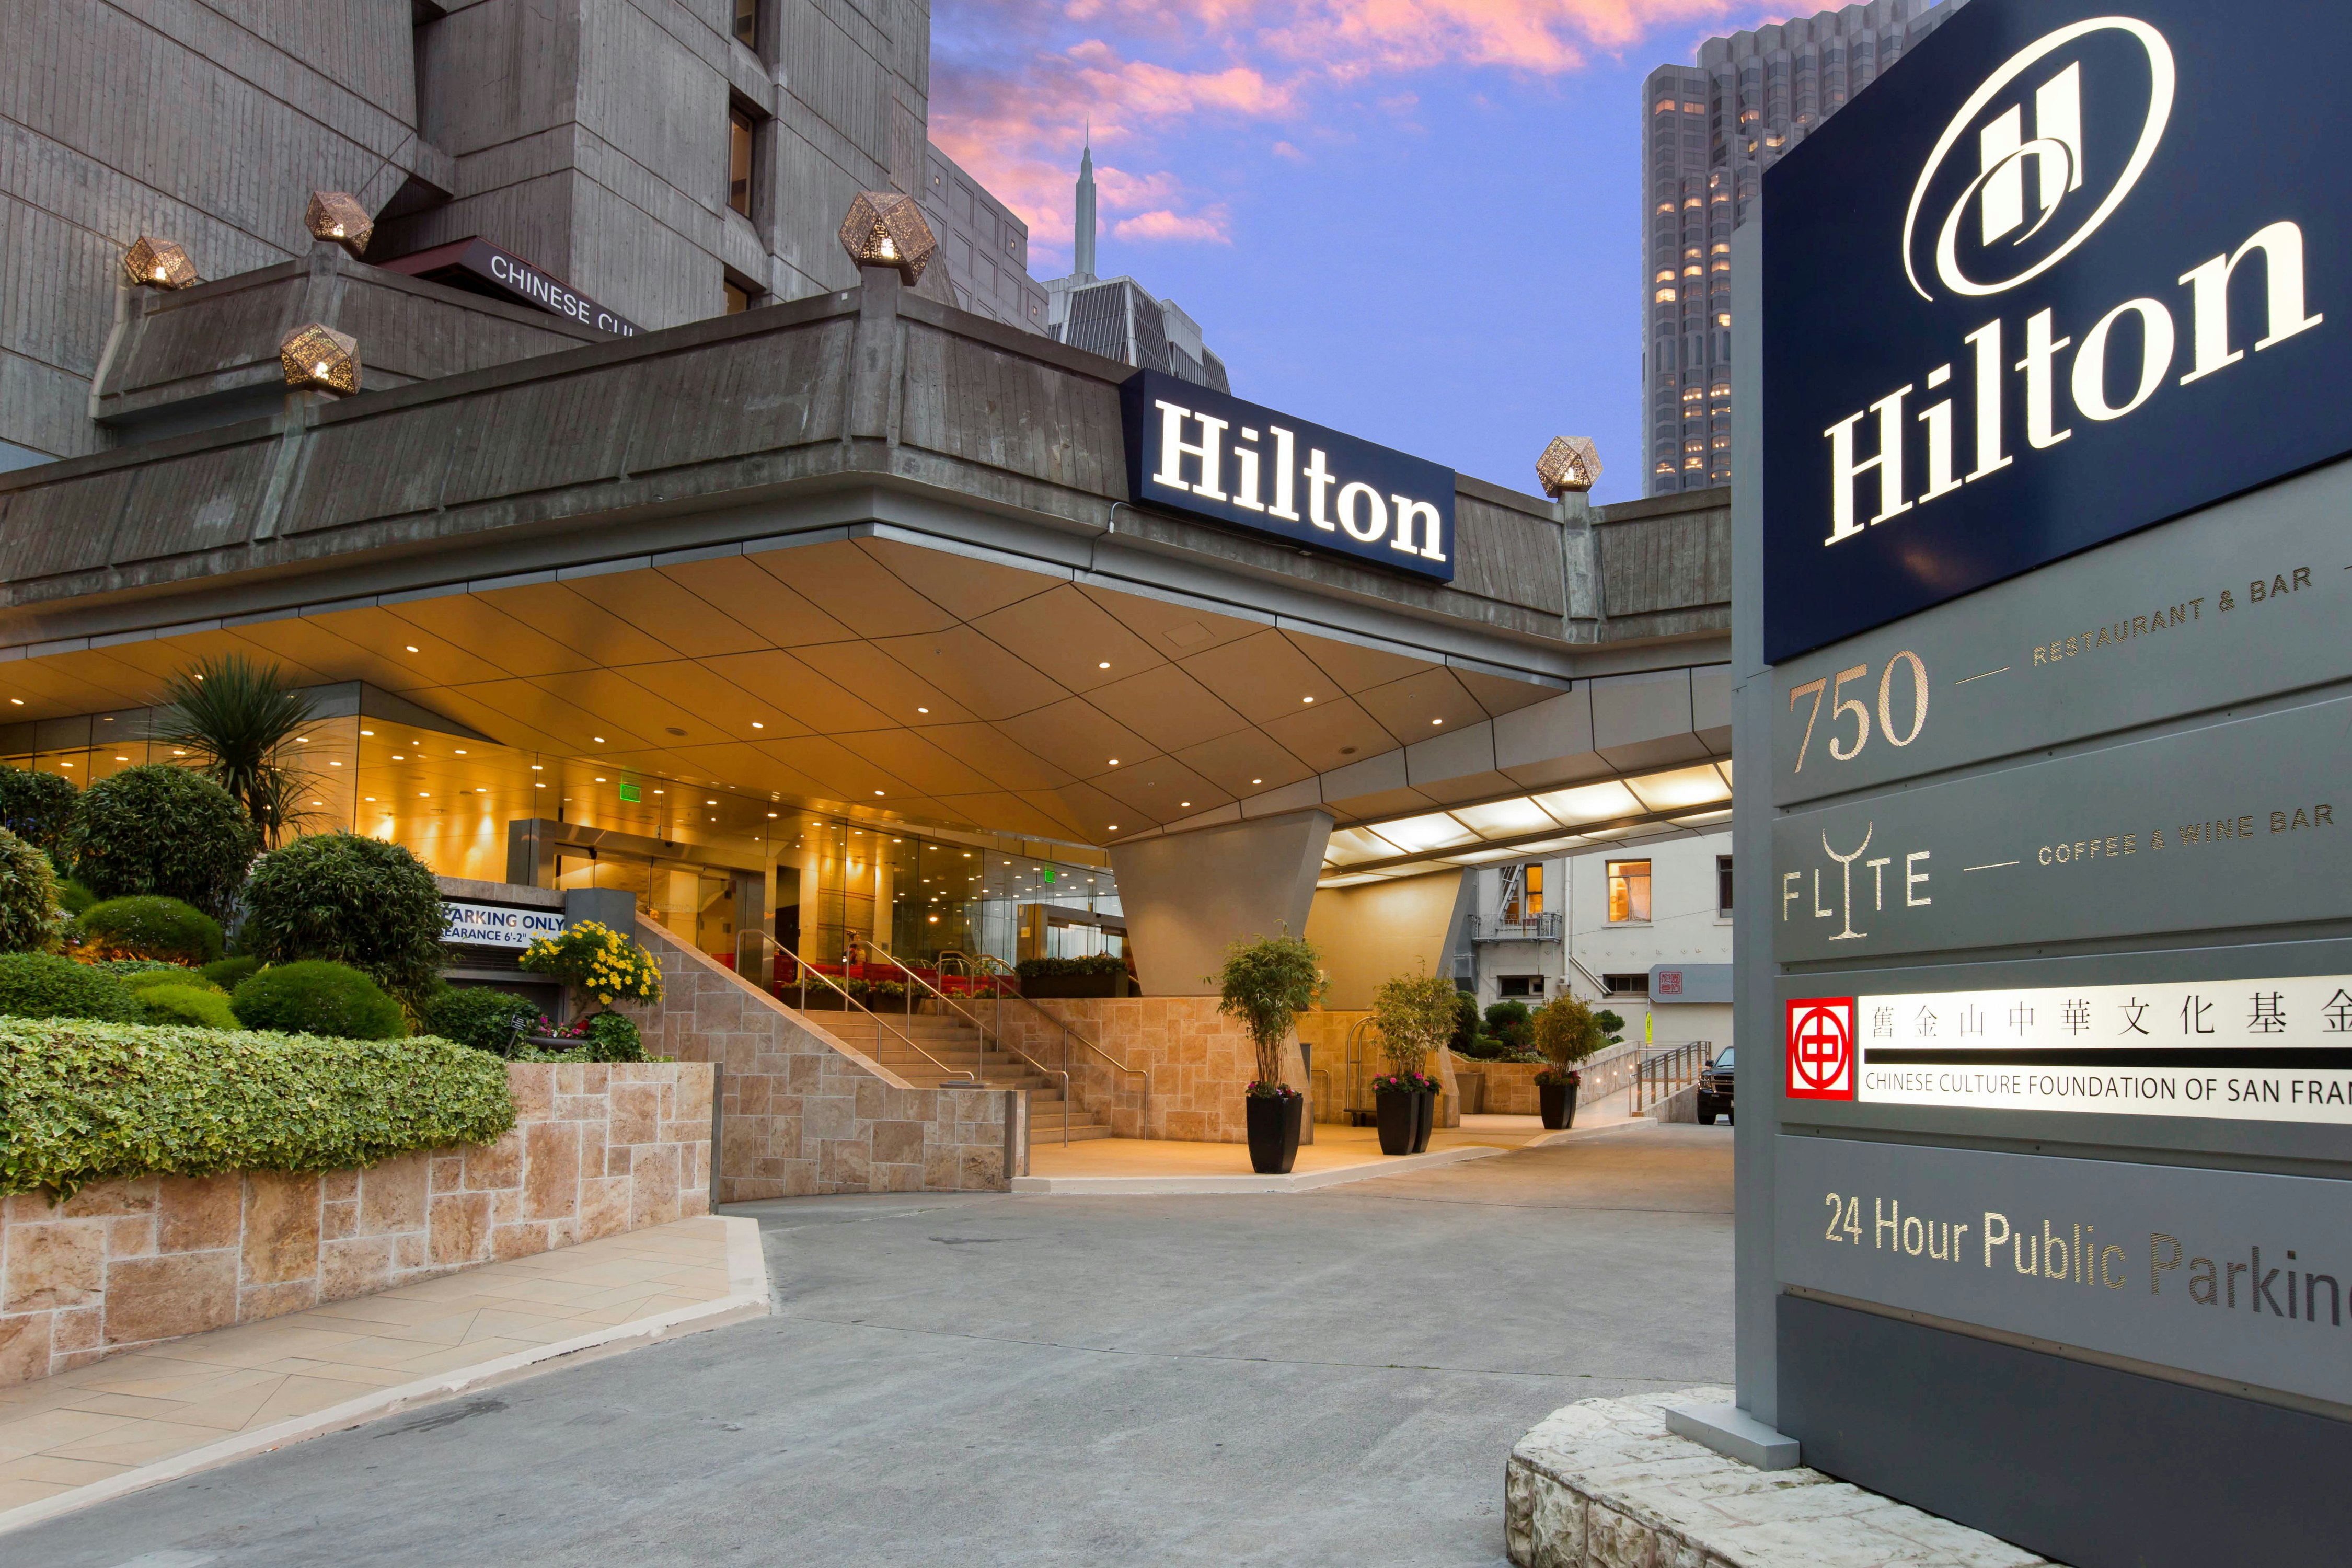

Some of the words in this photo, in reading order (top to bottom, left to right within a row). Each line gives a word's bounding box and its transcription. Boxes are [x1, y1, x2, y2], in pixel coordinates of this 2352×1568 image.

[491, 255, 590, 324] CHINESE
[1824, 221, 2323, 546] Hilton
[1152, 399, 1446, 562] Hilton
[1789, 650, 1929, 774] 750
[2033, 598, 2204, 667] RESTAURANT
[2219, 590, 2235, 612] &
[2250, 566, 2313, 603] BAR
[2038, 834, 2137, 866] COFFEE
[2152, 830, 2166, 850] &
[2178, 816, 2254, 847] WINE
[2270, 804, 2334, 834] BAR
[445, 927, 501, 941] EARANCE
[504, 932, 527, 942] 6'-2"
[522, 915, 566, 931] ONLY
[1866, 1072, 1933, 1091] CHINESE
[1940, 1074, 2021, 1094] CULTURE
[2029, 1076, 2175, 1099] FOUNDATION
[2185, 1078, 2217, 1101] OF
[2228, 1079, 2279, 1103] SAN
[2292, 1080, 2352, 1105] FRA
[1825, 1193, 1862, 1245] 24
[1876, 1197, 1968, 1261] Hour
[1985, 1212, 2127, 1290] Public
[2150, 1232, 2352, 1327] Parkin
